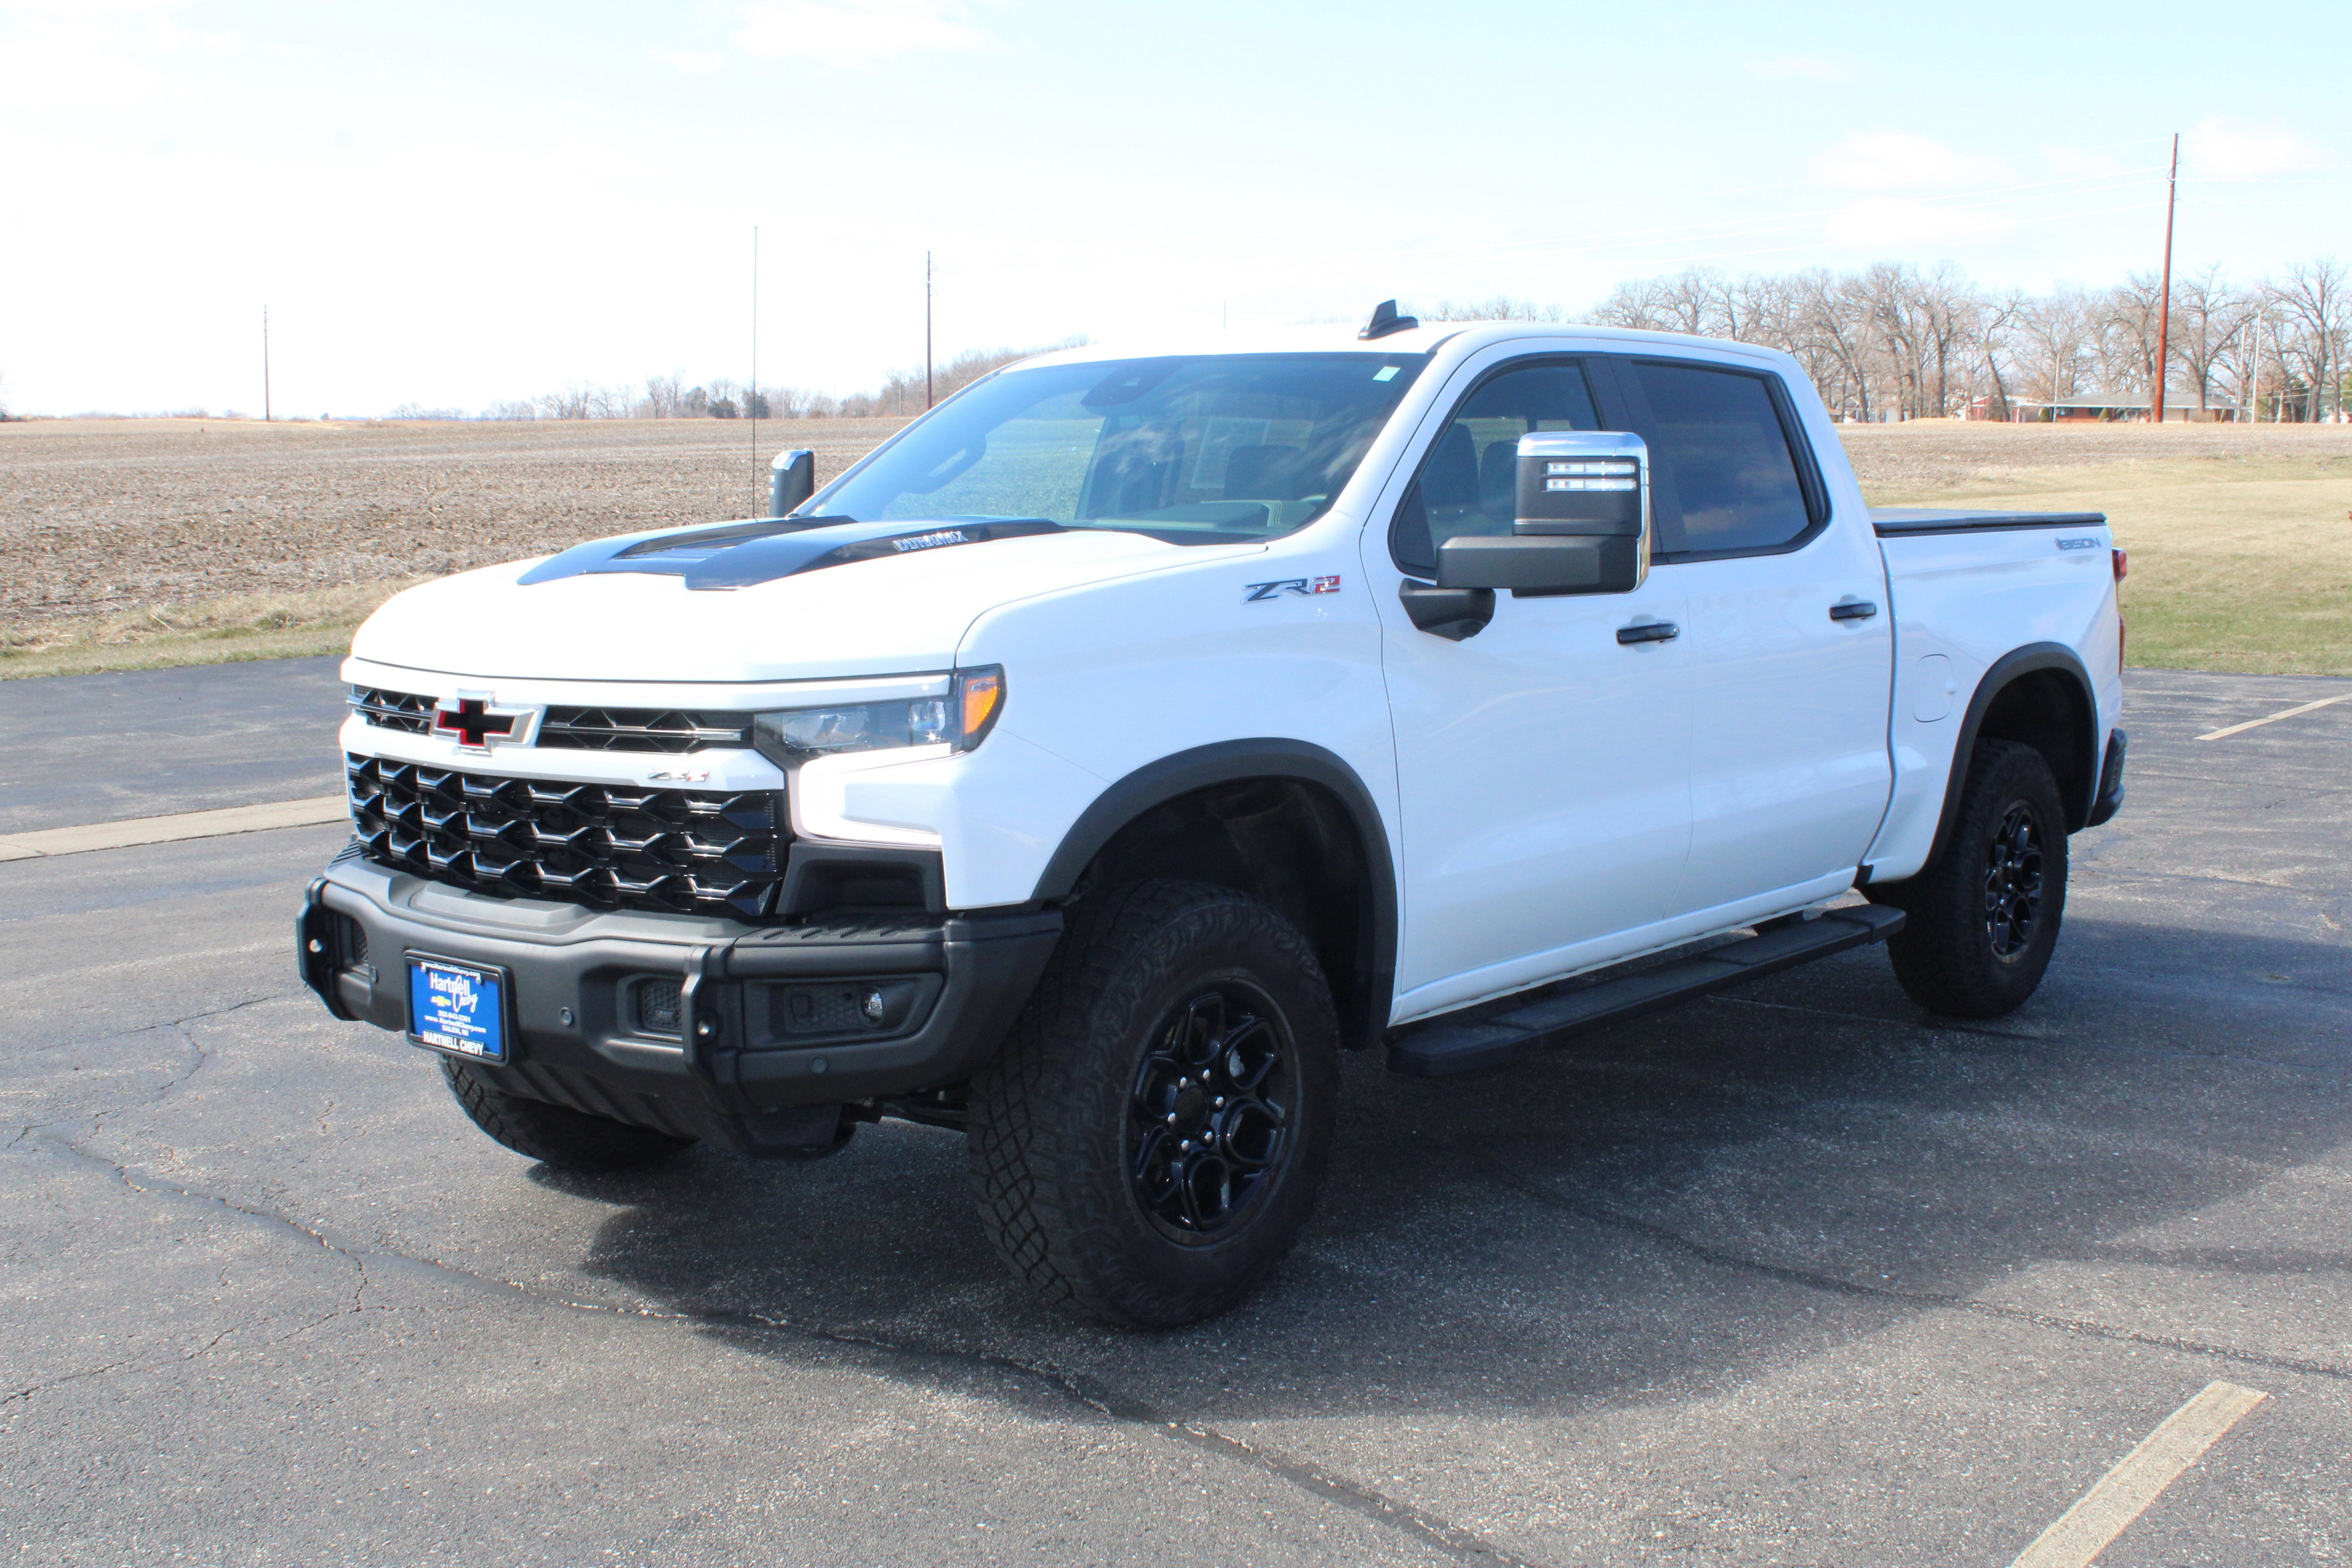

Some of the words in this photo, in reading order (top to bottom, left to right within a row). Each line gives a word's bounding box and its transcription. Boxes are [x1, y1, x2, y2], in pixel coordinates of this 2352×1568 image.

[893, 530, 969, 552] DURAMAX
[2055, 538, 2101, 551] BISON
[1241, 575, 1340, 604] ZR2
[430, 972, 470, 996] Hartnell
[452, 975, 478, 1013] Chevy
[439, 1017, 486, 1033] HartnellChevy.com
[441, 1025, 461, 1036] SALEM,
[423, 1031, 459, 1050] HARTNELL
[459, 1039, 484, 1056] CHEVY
